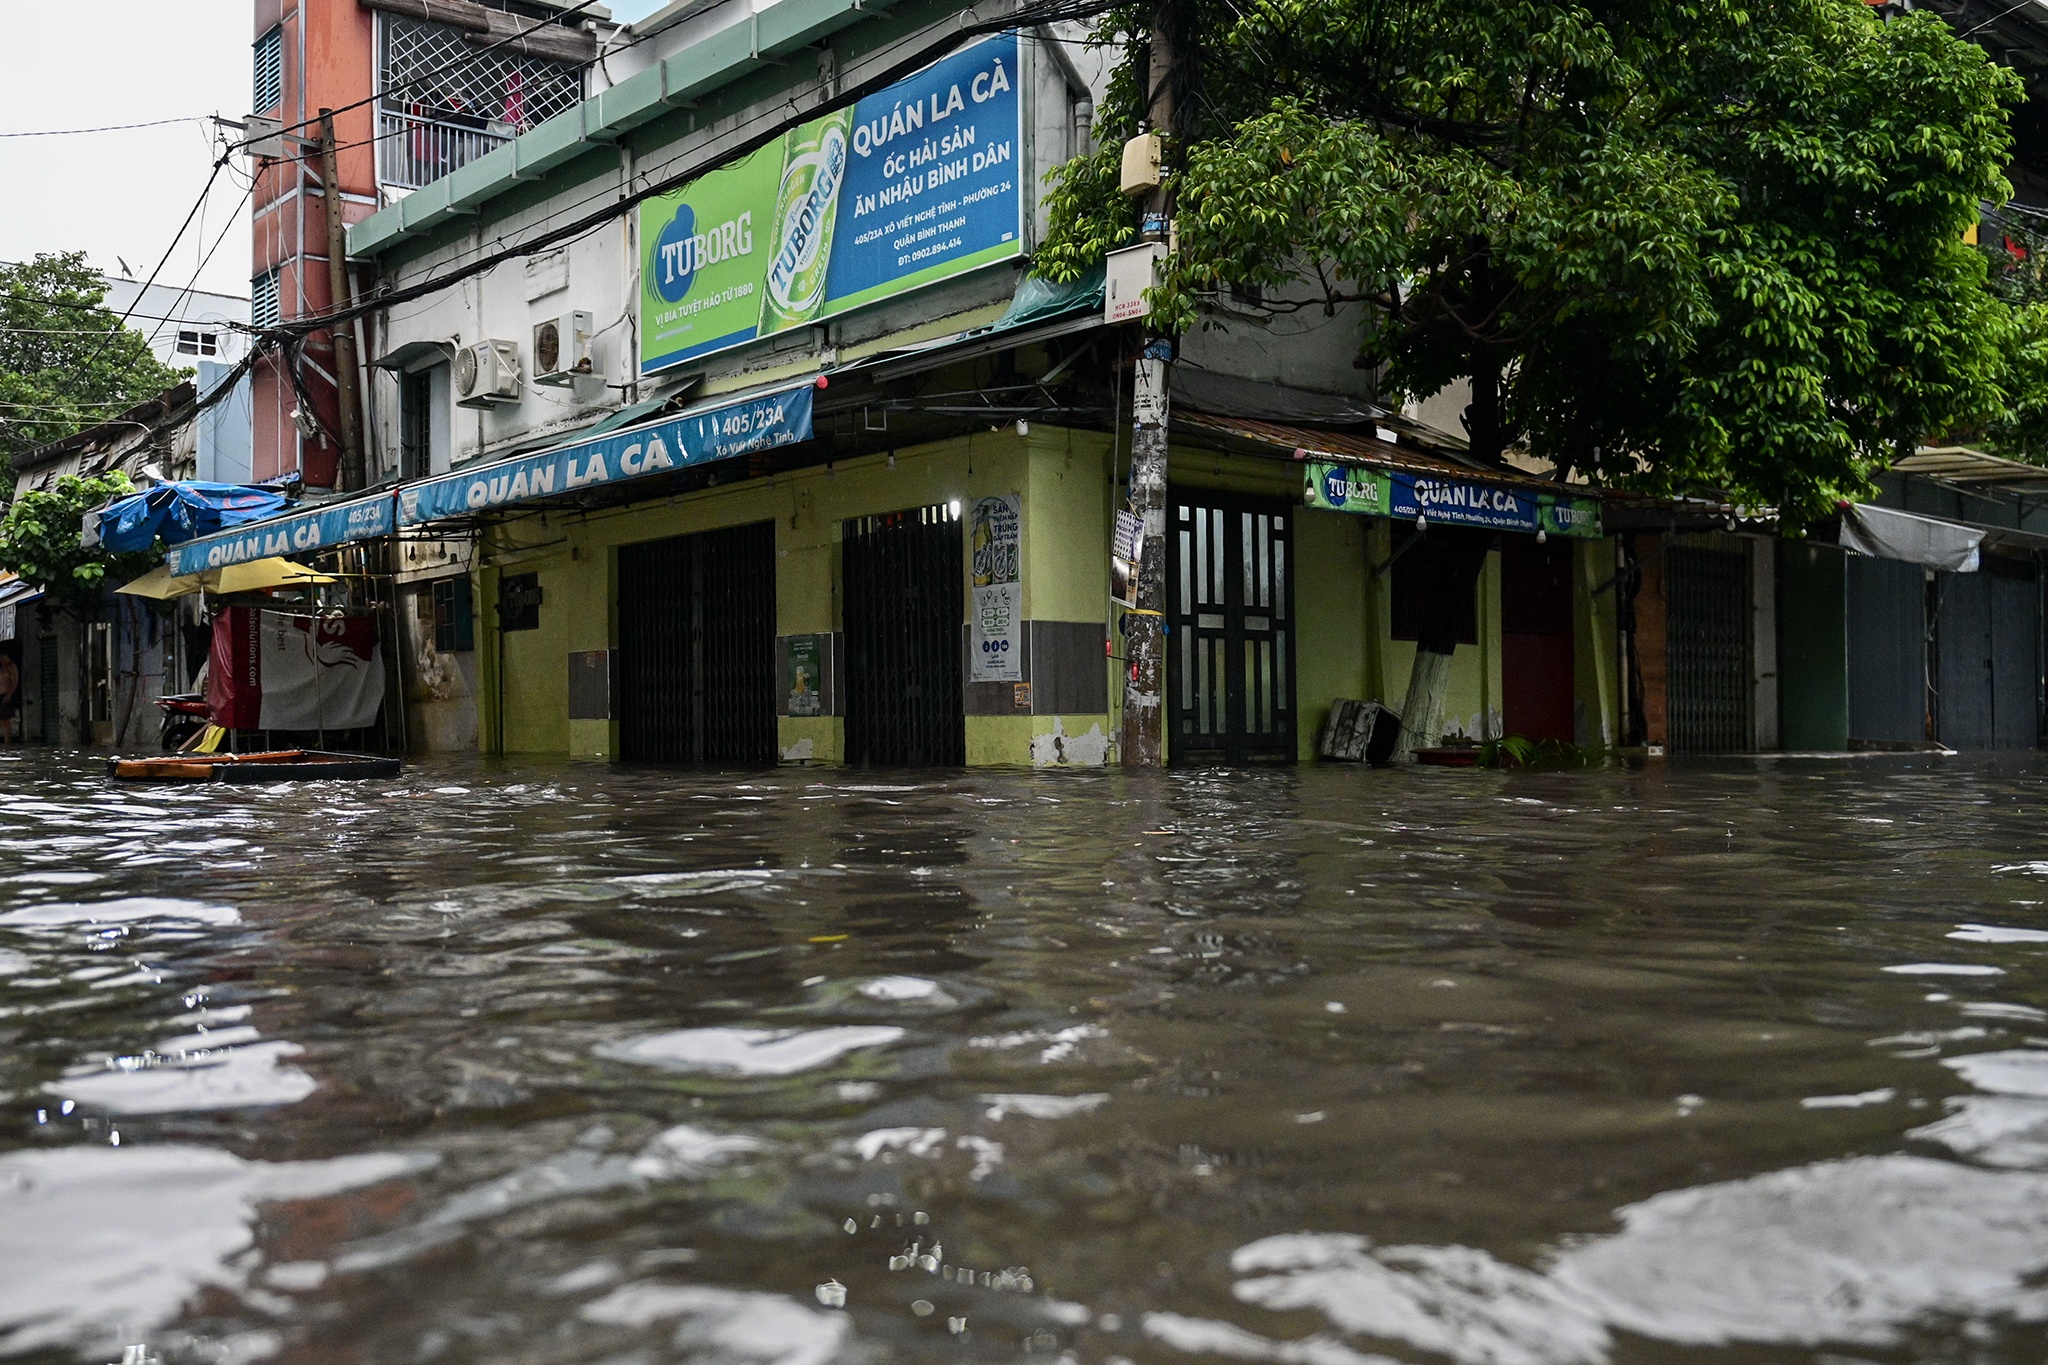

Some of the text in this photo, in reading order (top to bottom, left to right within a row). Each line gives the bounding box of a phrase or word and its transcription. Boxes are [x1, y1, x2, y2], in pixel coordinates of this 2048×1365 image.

[853, 57, 1010, 157] QUÁN LA CÀ
[883, 125, 975, 178] ỐC HẢI SẢN
[854, 141, 1010, 218] ĂN NHẬU BÌNH DÂN
[771, 167, 834, 293] TUBORG
[854, 227, 884, 245] 405/23A
[884, 220, 896, 235] XÔ
[897, 214, 913, 230] VIẾT
[914, 205, 936, 224] NGHỆ
[937, 200, 956, 216] TĨNH
[963, 185, 999, 207] PHƯỜNG
[1000, 180, 1012, 193] 24
[893, 215, 966, 250] QUẬN BÌNH THẠNH
[662, 210, 753, 285] TUBORG
[810, 243, 829, 285] GREEN
[898, 236, 962, 267] ĐT: 0902.894.414
[655, 282, 753, 328] VỊ BIA TUYỆT HẢO TỪ 1880
[723, 405, 785, 436] 405/23A
[467, 465, 555, 509] QUÁN
[566, 453, 609, 488] LA
[620, 433, 673, 476] CÀ
[1329, 477, 1378, 501] TUBORG
[1413, 478, 1518, 512] QUÁN LA CÀ
[208, 536, 259, 566] QUÁN
[264, 531, 289, 555] LA
[294, 518, 321, 548] CÀ
[277, 629, 287, 651] best
